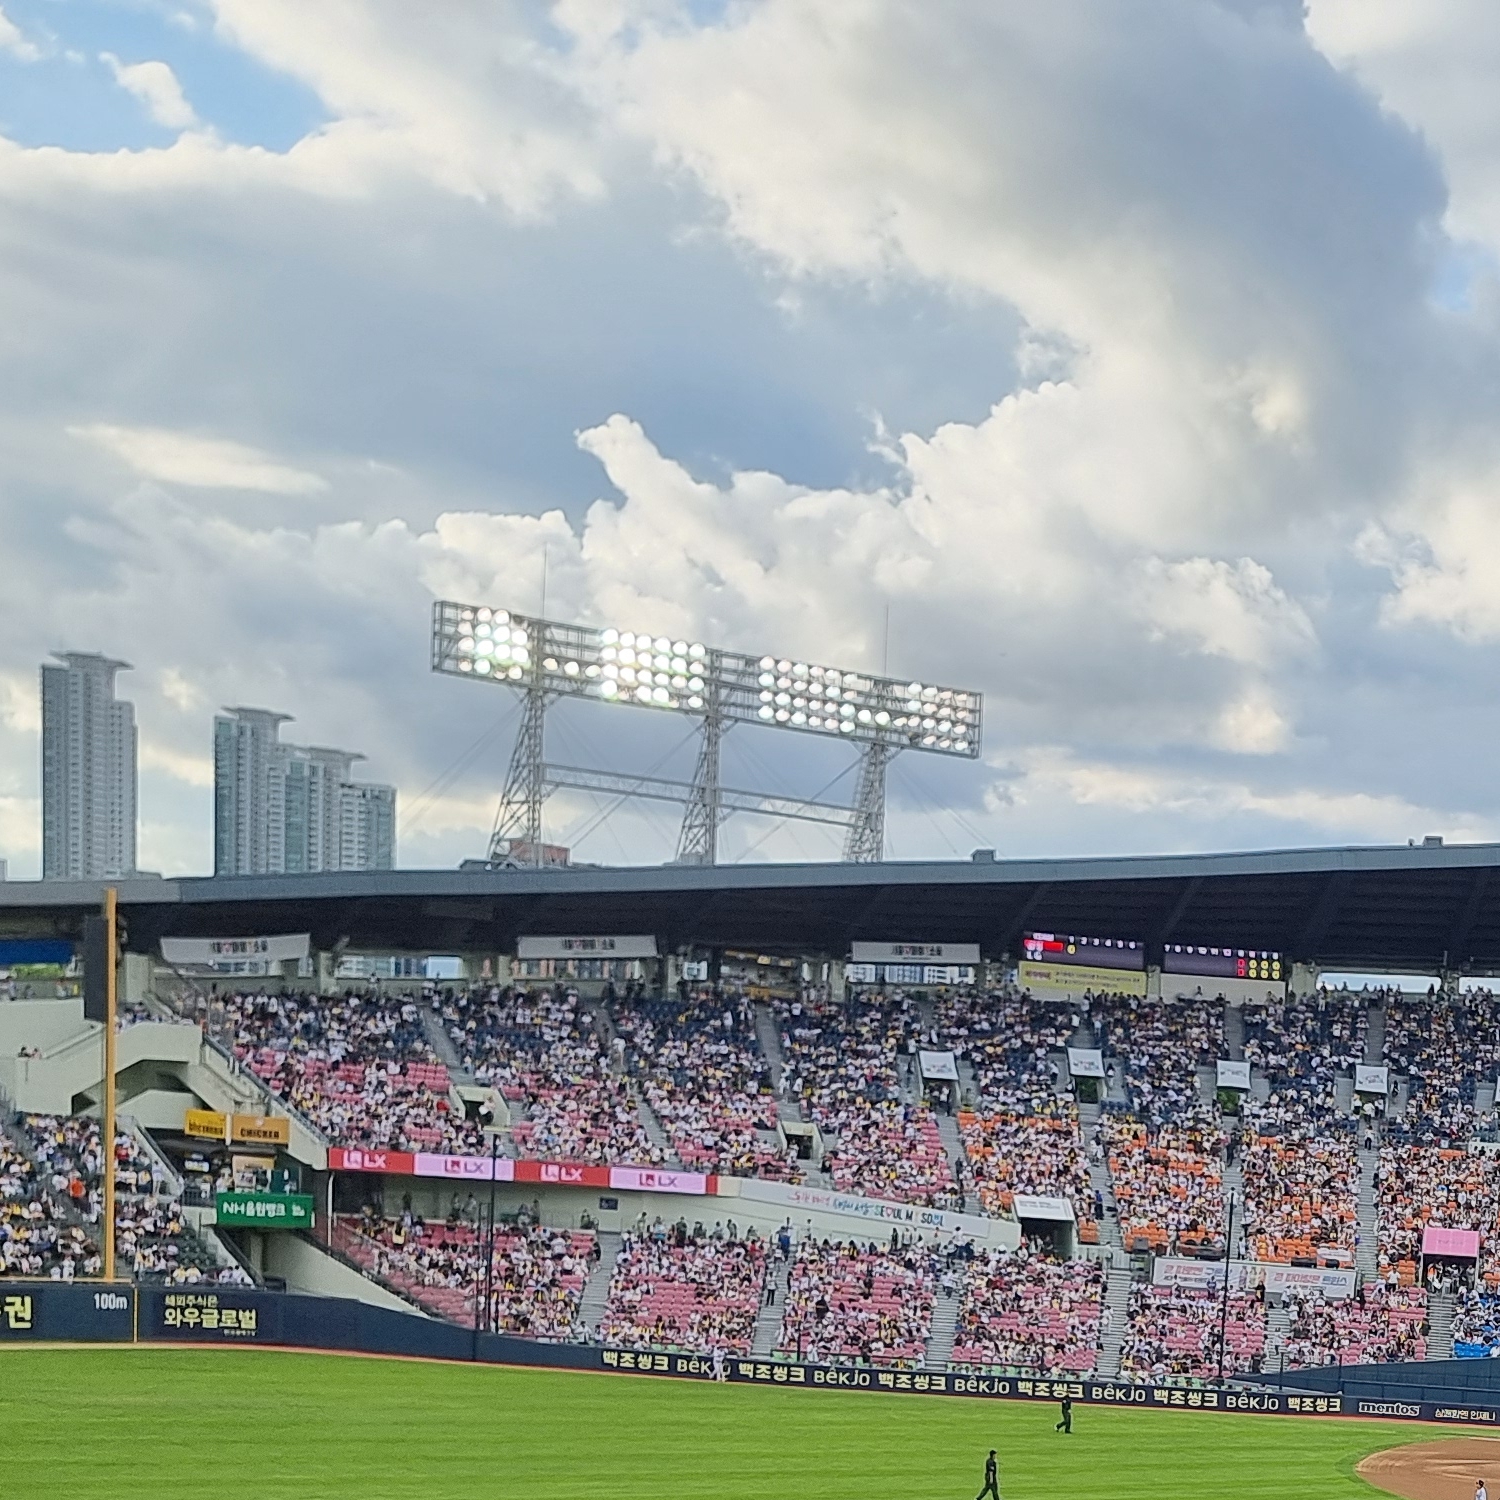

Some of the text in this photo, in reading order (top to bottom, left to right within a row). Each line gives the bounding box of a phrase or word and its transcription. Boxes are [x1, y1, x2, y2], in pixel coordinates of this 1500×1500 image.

[364, 1153, 386, 1169] LX
[464, 1160, 484, 1174] LX
[560, 1167, 583, 1182] LX
[658, 1174, 678, 1188] LX
[94, 1293, 128, 1310] 100m
[0, 1295, 32, 1328] 권
[164, 1307, 257, 1330] 와우글로벌
[602, 1350, 669, 1371] 백조씽크
[738, 1361, 805, 1383] 백조씽크
[878, 1372, 947, 1391] 백조씽크
[1017, 1380, 1084, 1399] 백조씽크
[1153, 1388, 1218, 1408] 백조씽크
[1287, 1397, 1342, 1413] 백조씽크
[1358, 1401, 1421, 1417] mentos
